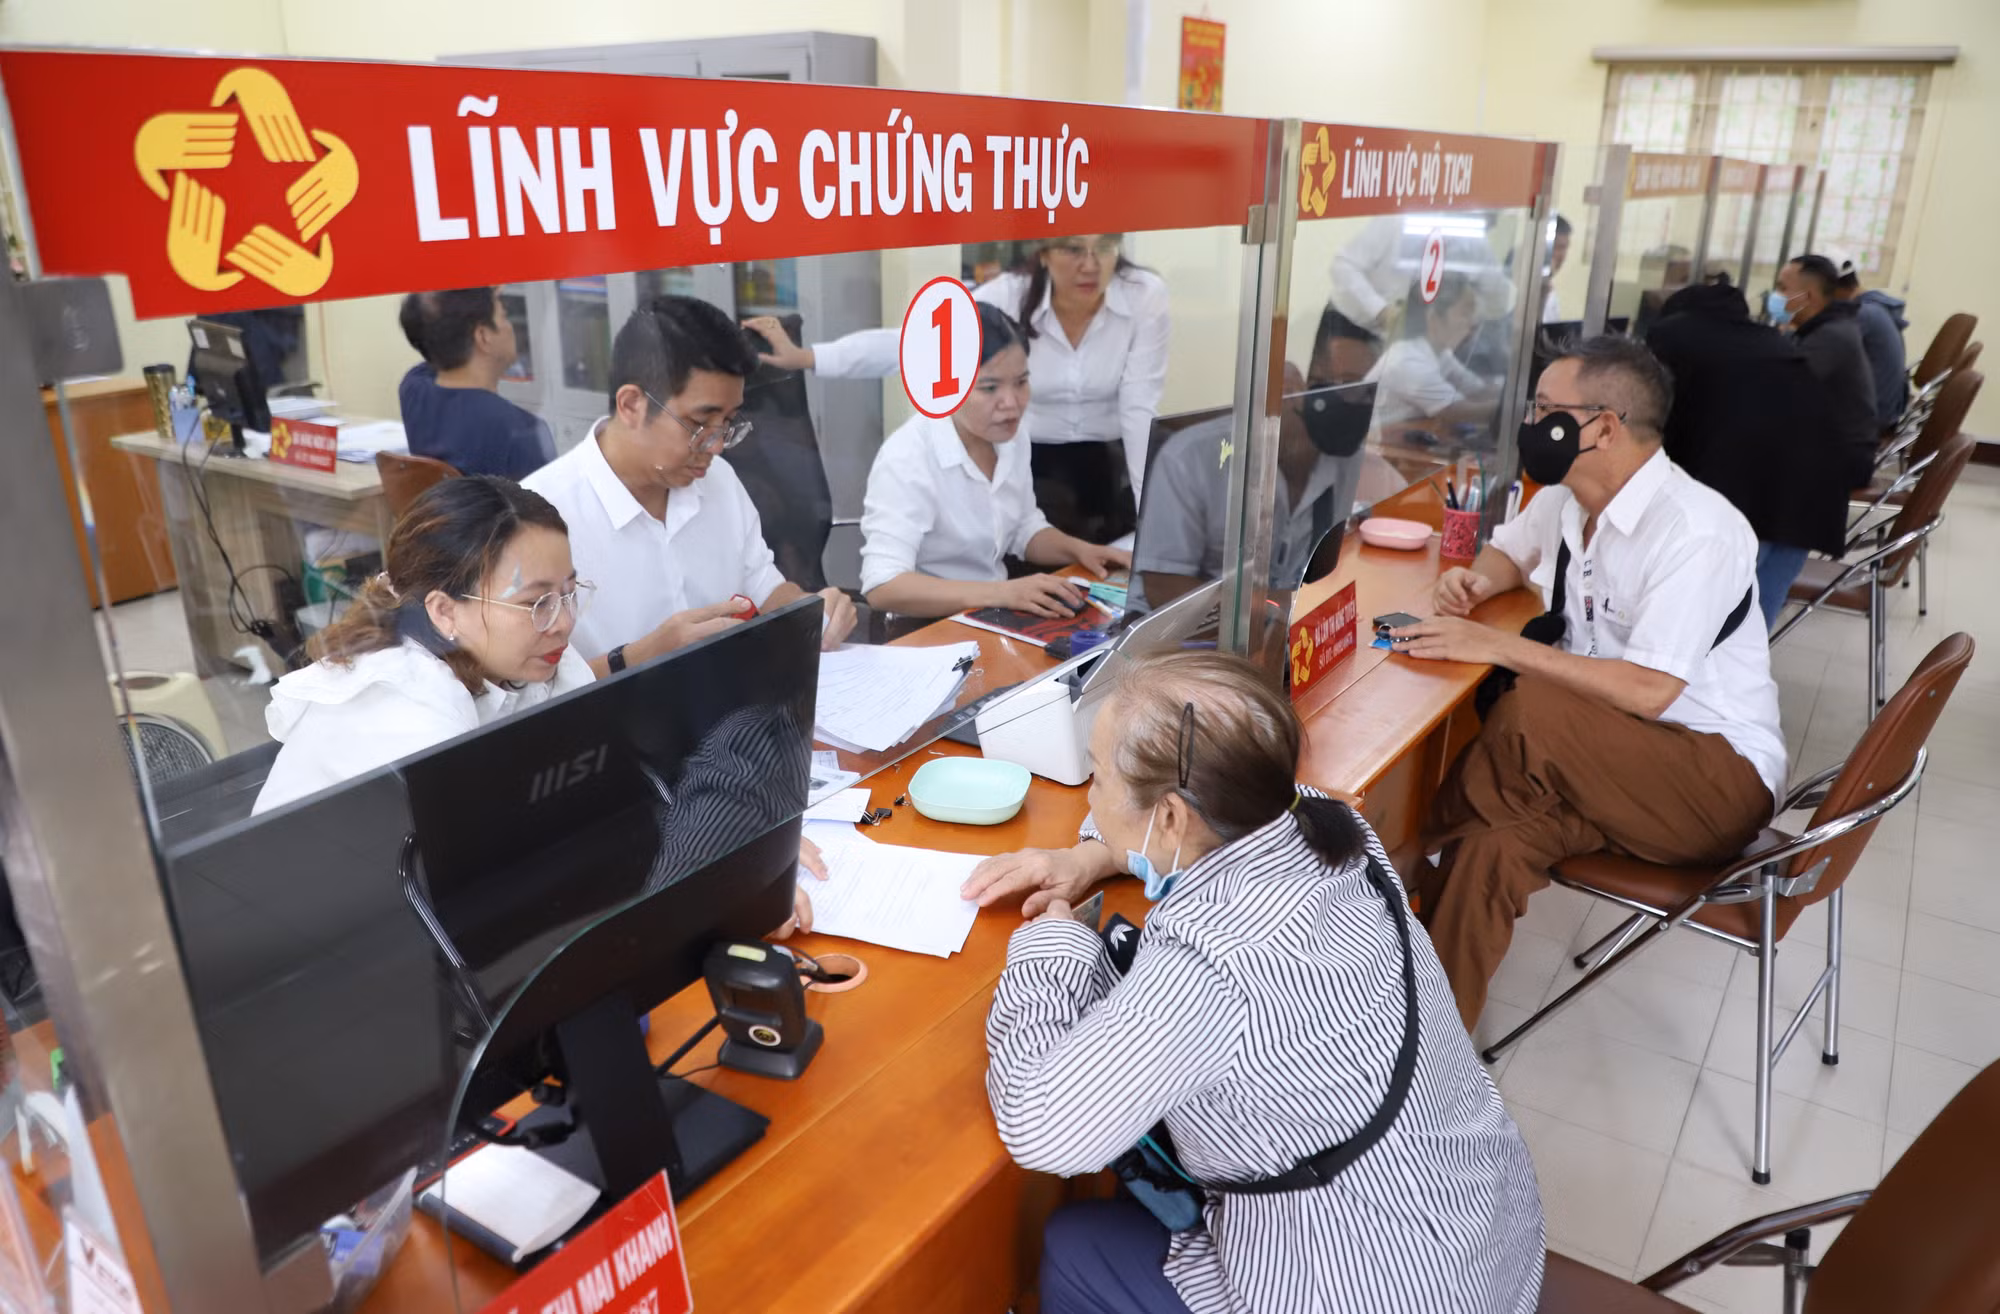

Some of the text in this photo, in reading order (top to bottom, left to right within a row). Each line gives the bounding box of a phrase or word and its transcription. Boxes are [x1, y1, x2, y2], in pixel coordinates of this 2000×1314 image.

[407, 95, 1090, 245] LĨNH VỰC CHỨNG THỰC
[1342, 137, 1473, 206] LĨNH VỰC HỘ TỊCH
[1426, 239, 1440, 292] 2
[931, 298, 959, 399] 1
[529, 744, 608, 804] MSI
[576, 1212, 674, 1314] MAI KHANH
